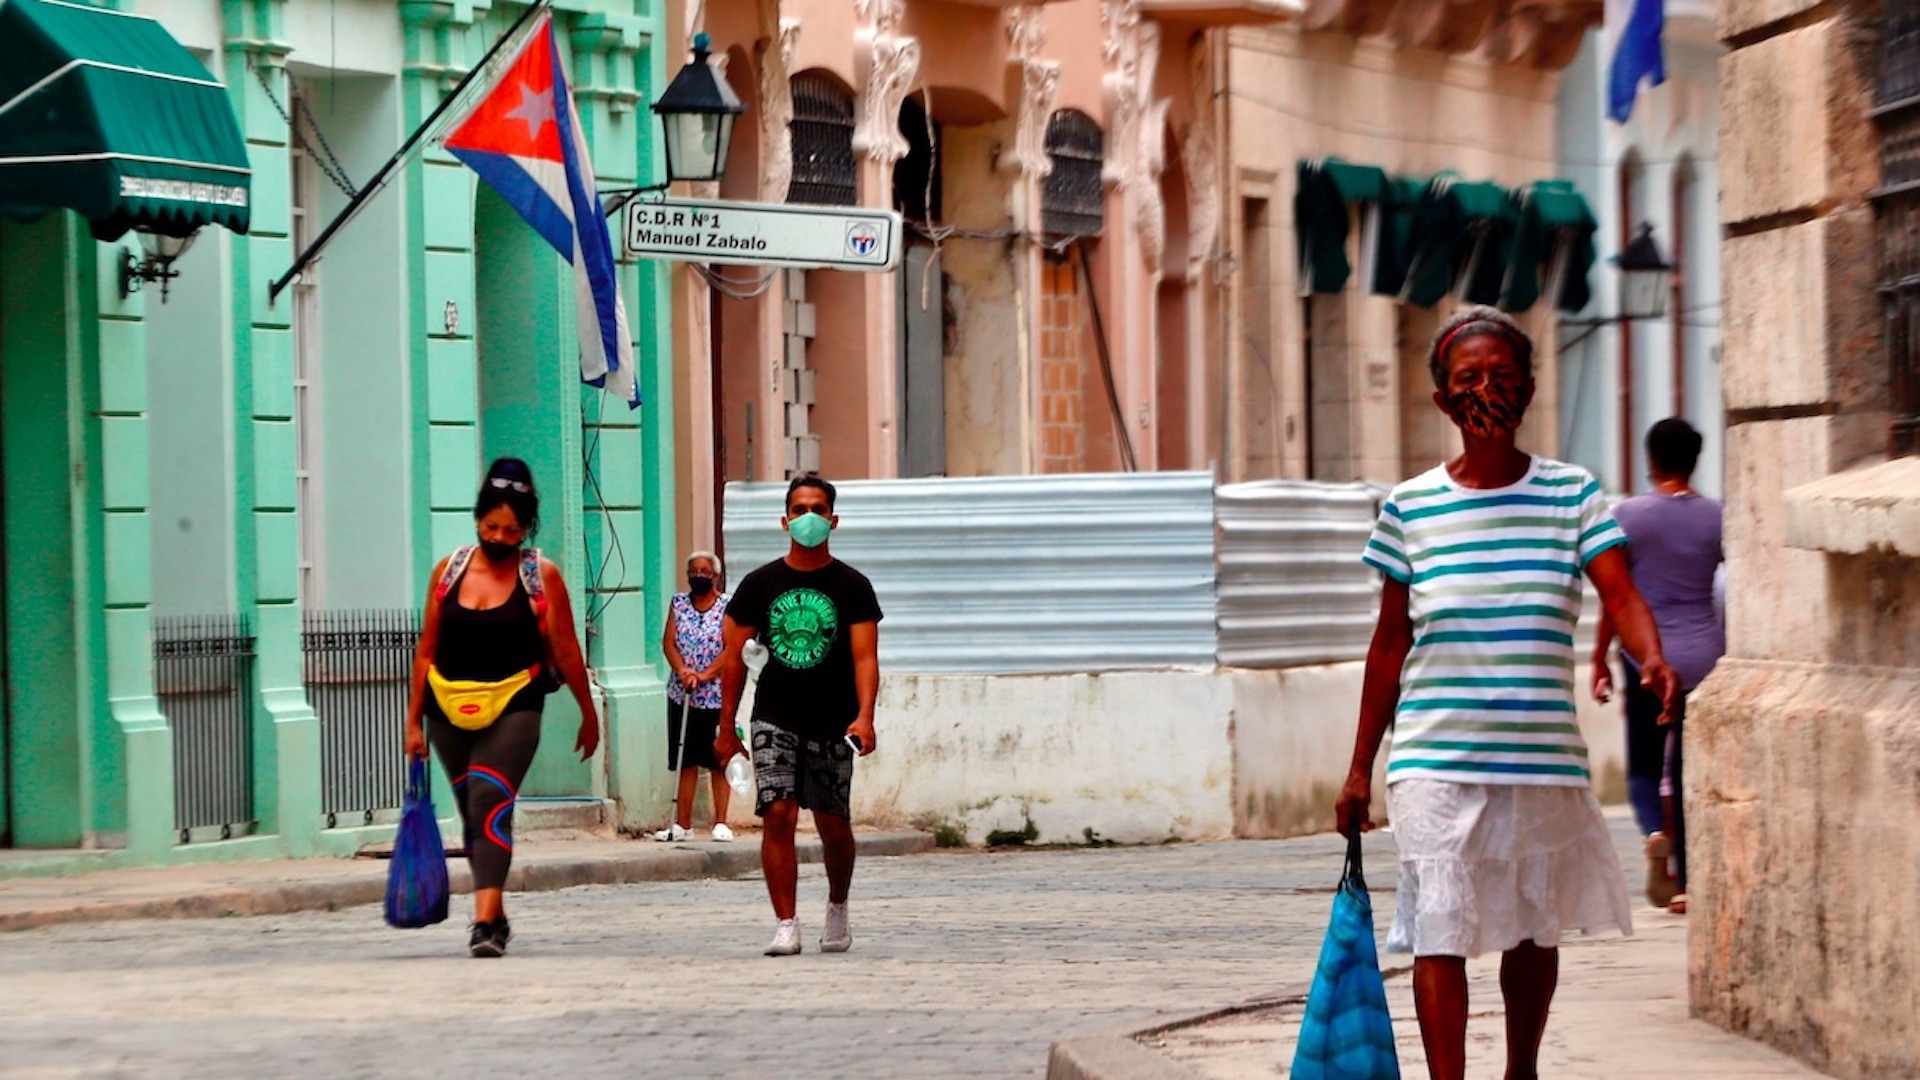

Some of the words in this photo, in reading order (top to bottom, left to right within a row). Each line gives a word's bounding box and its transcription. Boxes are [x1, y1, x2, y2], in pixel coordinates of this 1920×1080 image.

[637, 211, 684, 226] C.D.R
[636, 229, 700, 246] Manuel
[706, 234, 767, 251] Zabalo
[776, 594, 799, 613] FIVE
[786, 648, 812, 663] YORK
